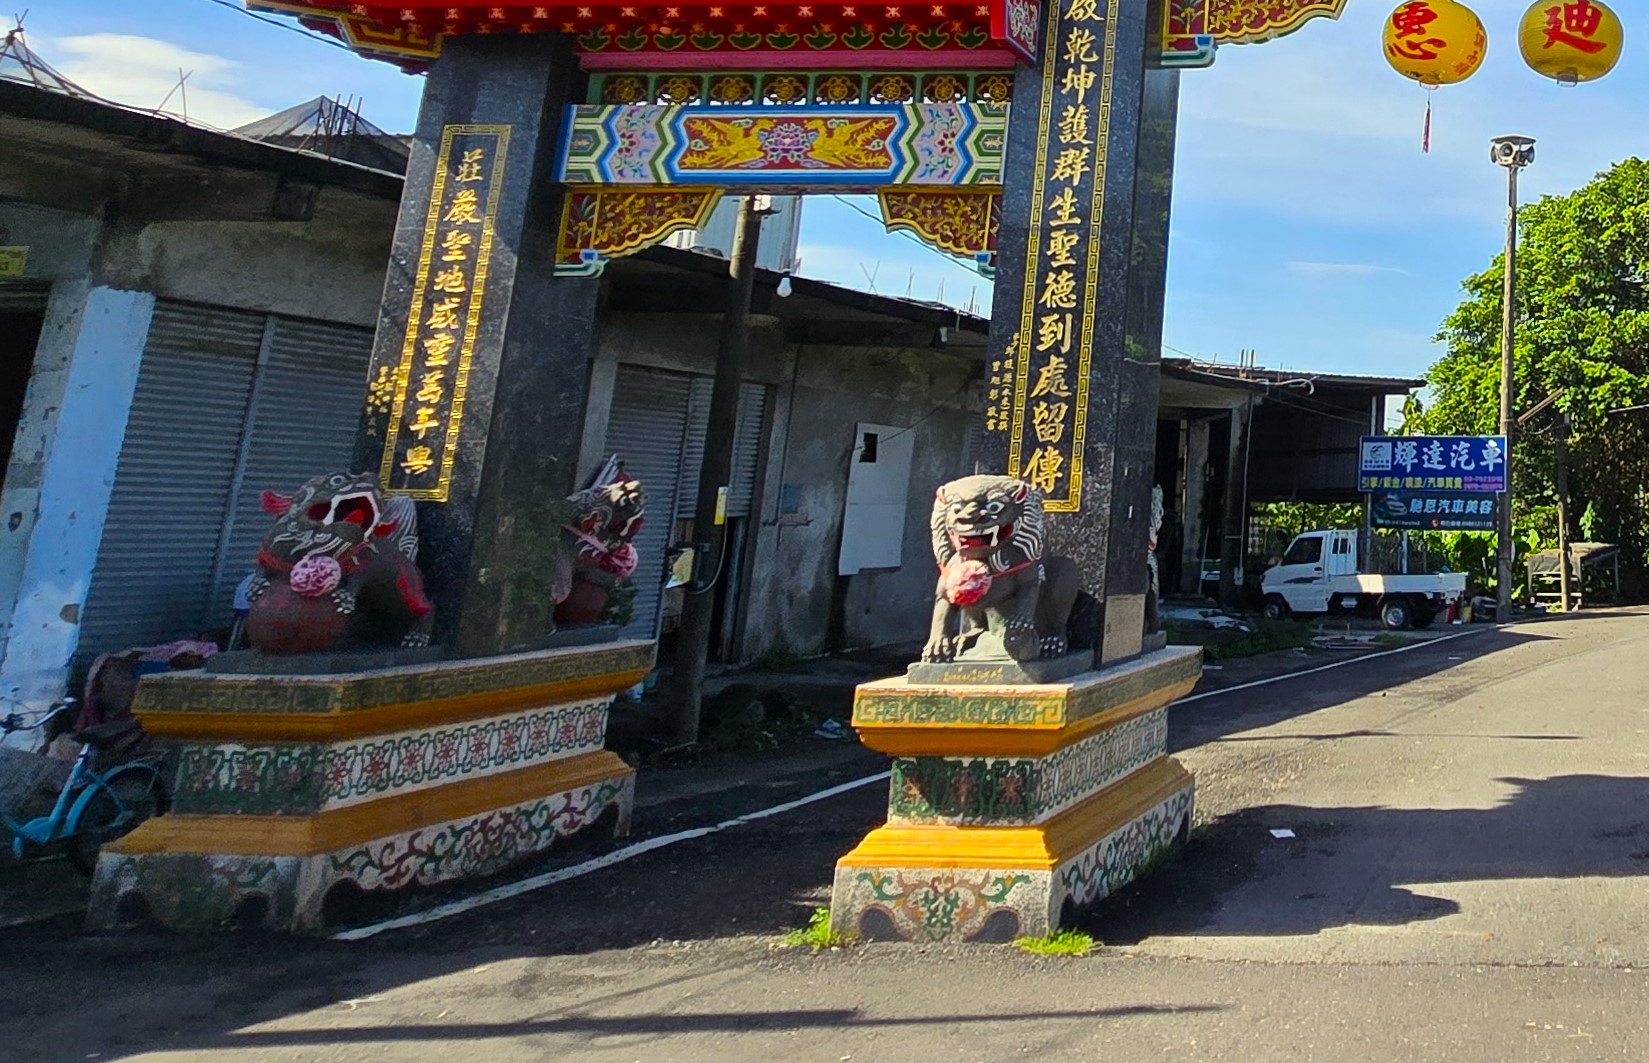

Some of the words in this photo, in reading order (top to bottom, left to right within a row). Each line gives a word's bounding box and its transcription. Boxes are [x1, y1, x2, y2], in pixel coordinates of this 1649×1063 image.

[1386, 1, 1447, 60] 惠
[1394, 439, 1503, 473] 輝達汽車
